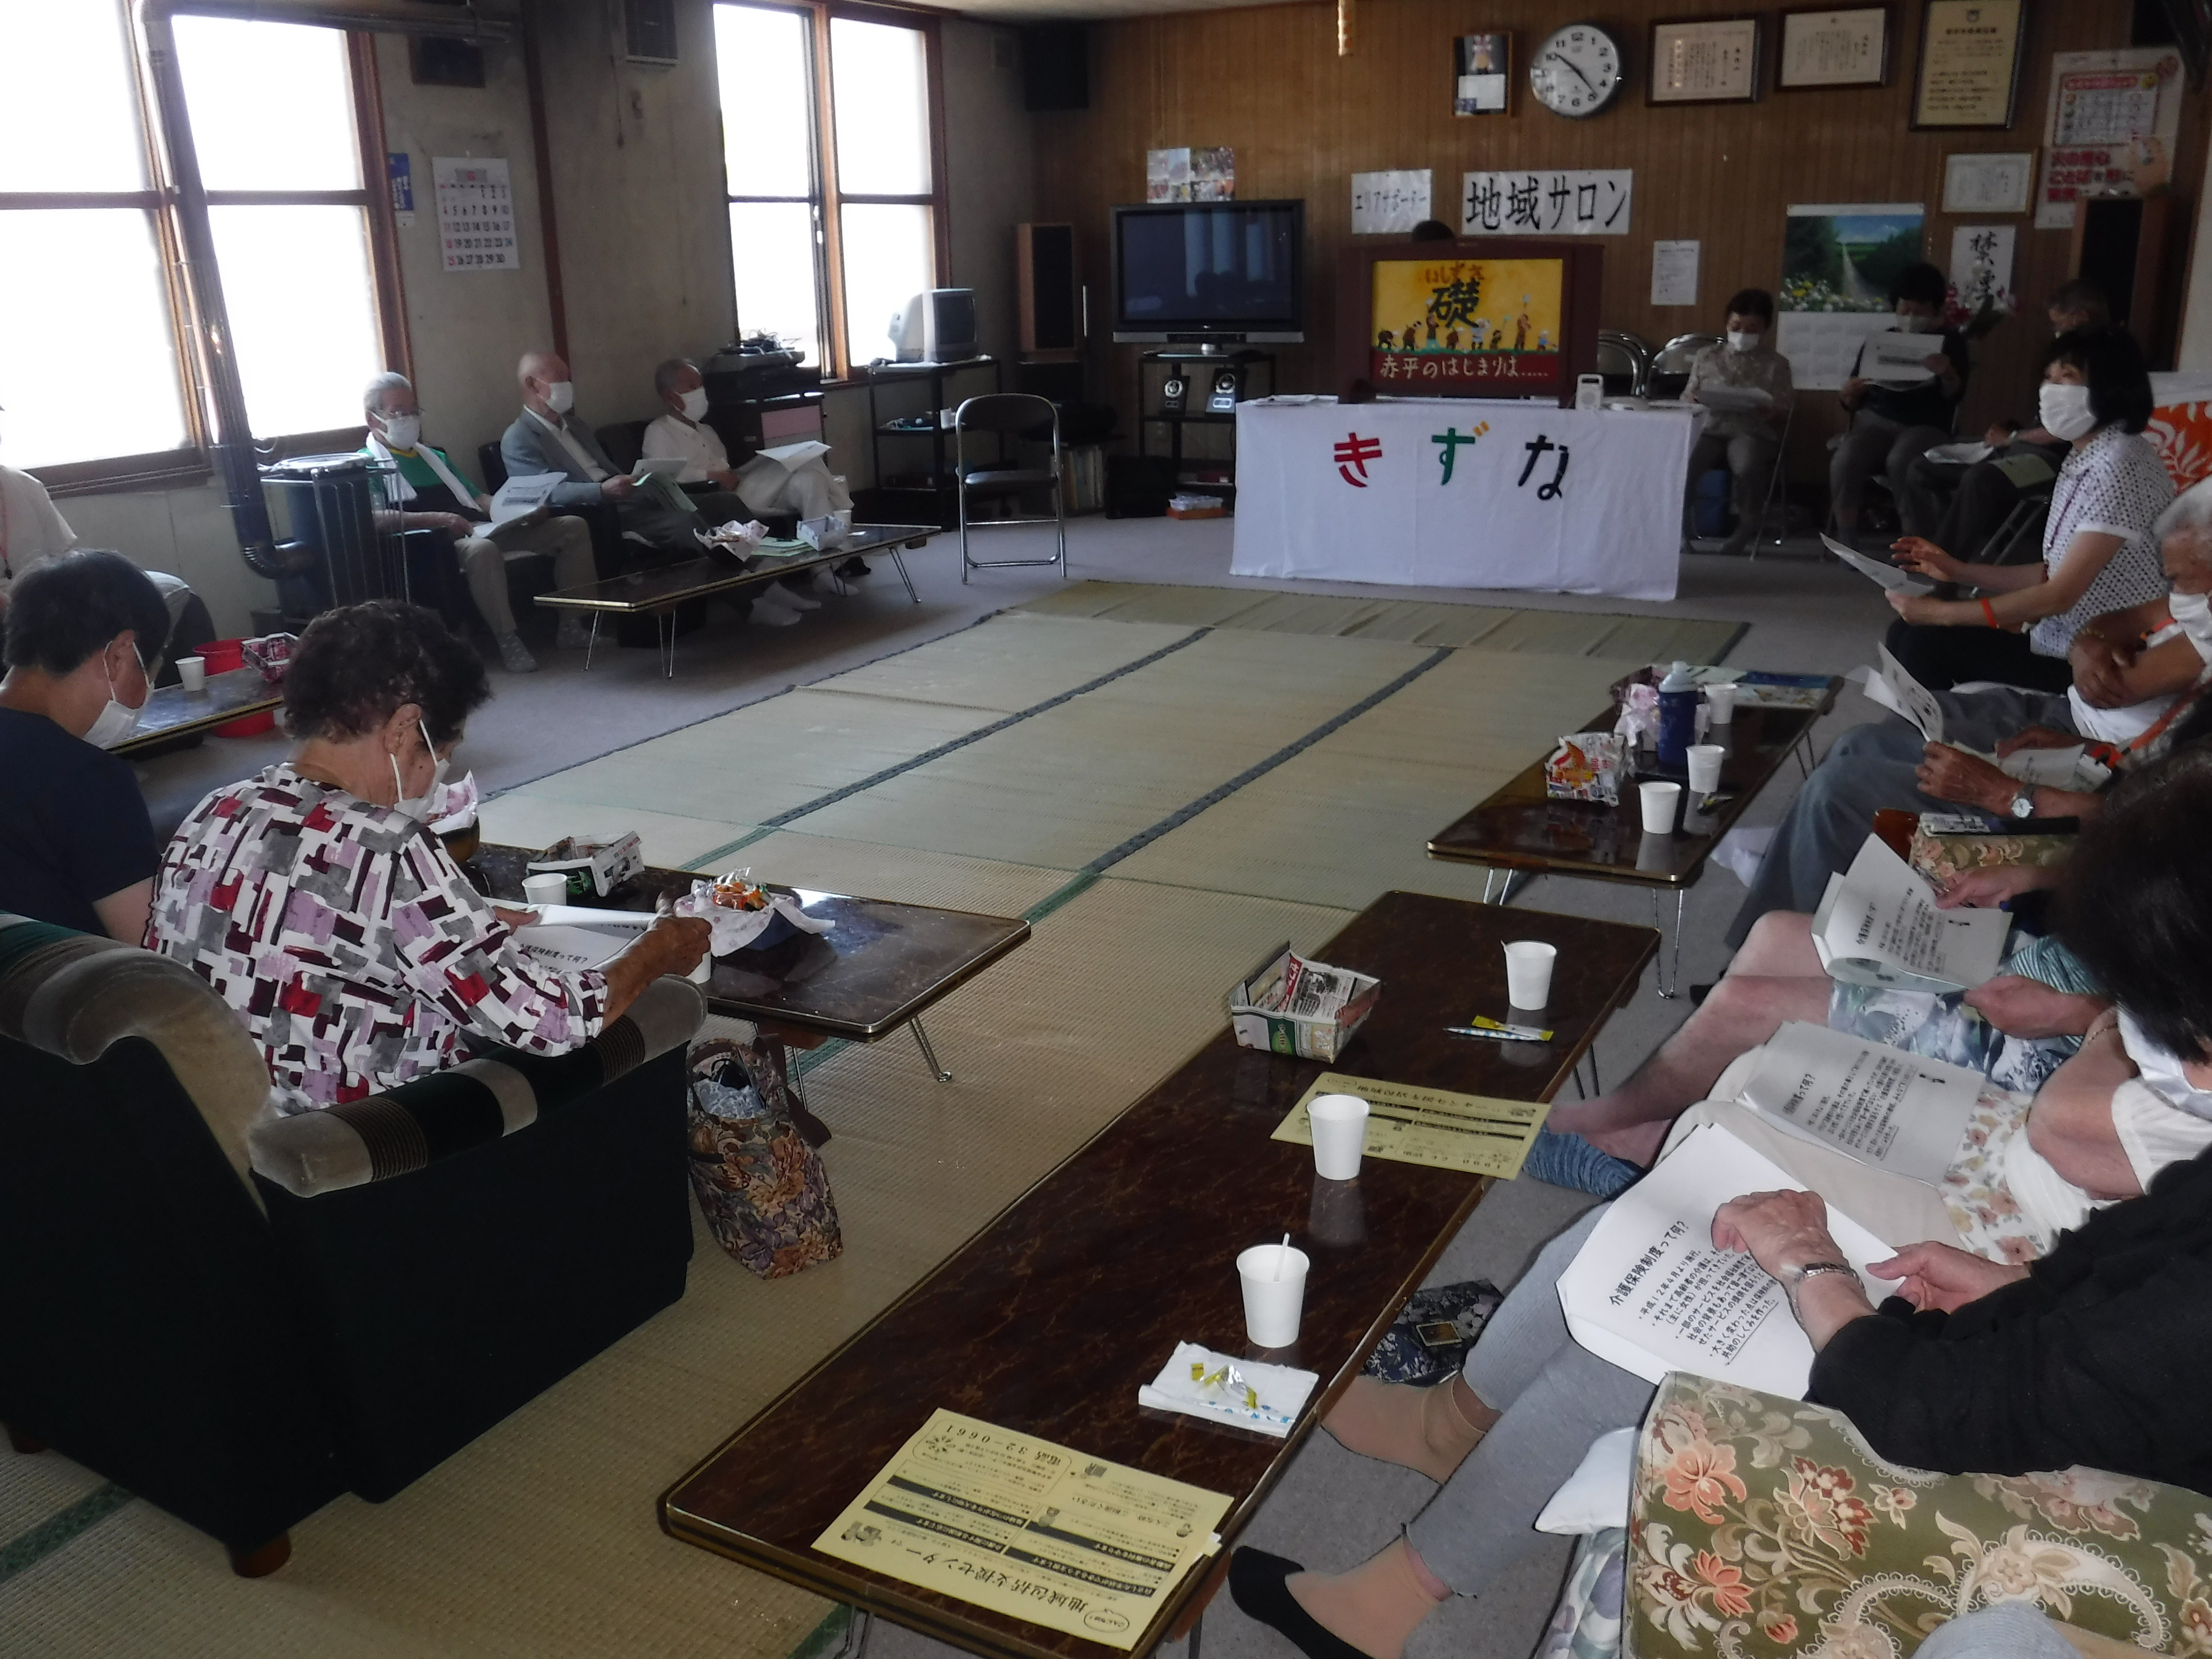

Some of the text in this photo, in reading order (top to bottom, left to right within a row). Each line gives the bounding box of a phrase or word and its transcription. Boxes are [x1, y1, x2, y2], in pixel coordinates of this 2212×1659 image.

[1465, 175, 1627, 230] 地域サロン
[1428, 279, 1480, 328] 礎
[1334, 421, 1569, 501] きずな
[1610, 1221, 1689, 1306] 介護保険制度って何?
[900, 1543, 1090, 1614] 地域包括支援センター
